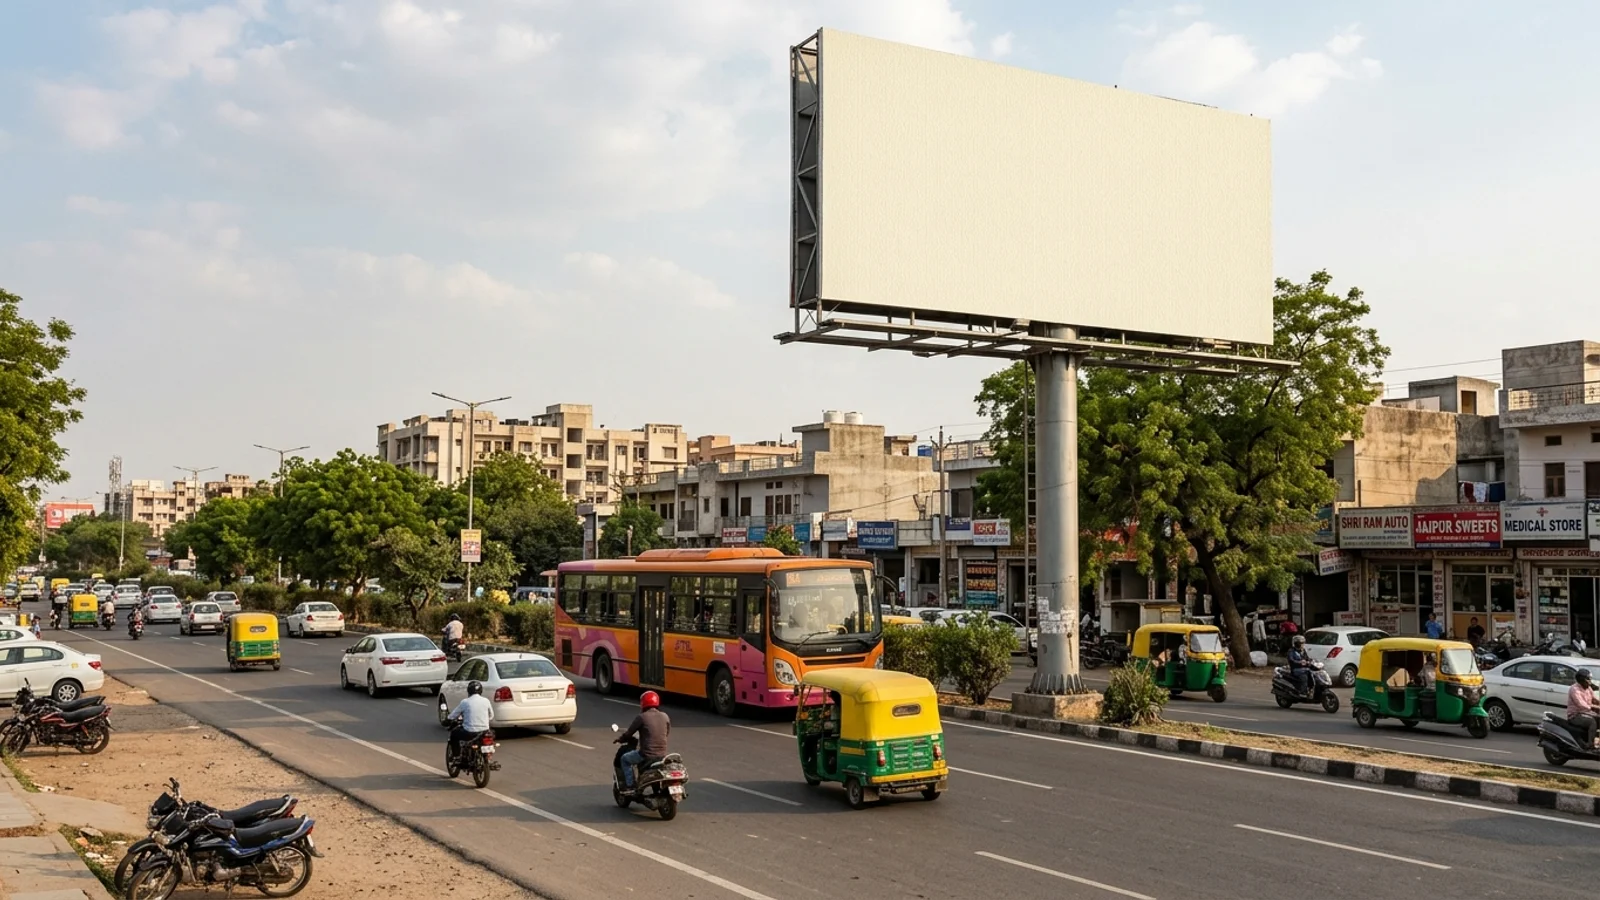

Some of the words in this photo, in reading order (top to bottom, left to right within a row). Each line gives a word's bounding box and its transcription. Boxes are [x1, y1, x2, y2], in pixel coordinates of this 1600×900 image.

[1342, 517, 1361, 528] SHRI
[1364, 517, 1382, 528] RAM
[1384, 516, 1408, 528] AUTO
[1415, 520, 1453, 533] JAIPUR
[1455, 519, 1498, 533] SWEETS
[1504, 520, 1547, 532] MEDICAL
[1549, 519, 1582, 531] STORE
